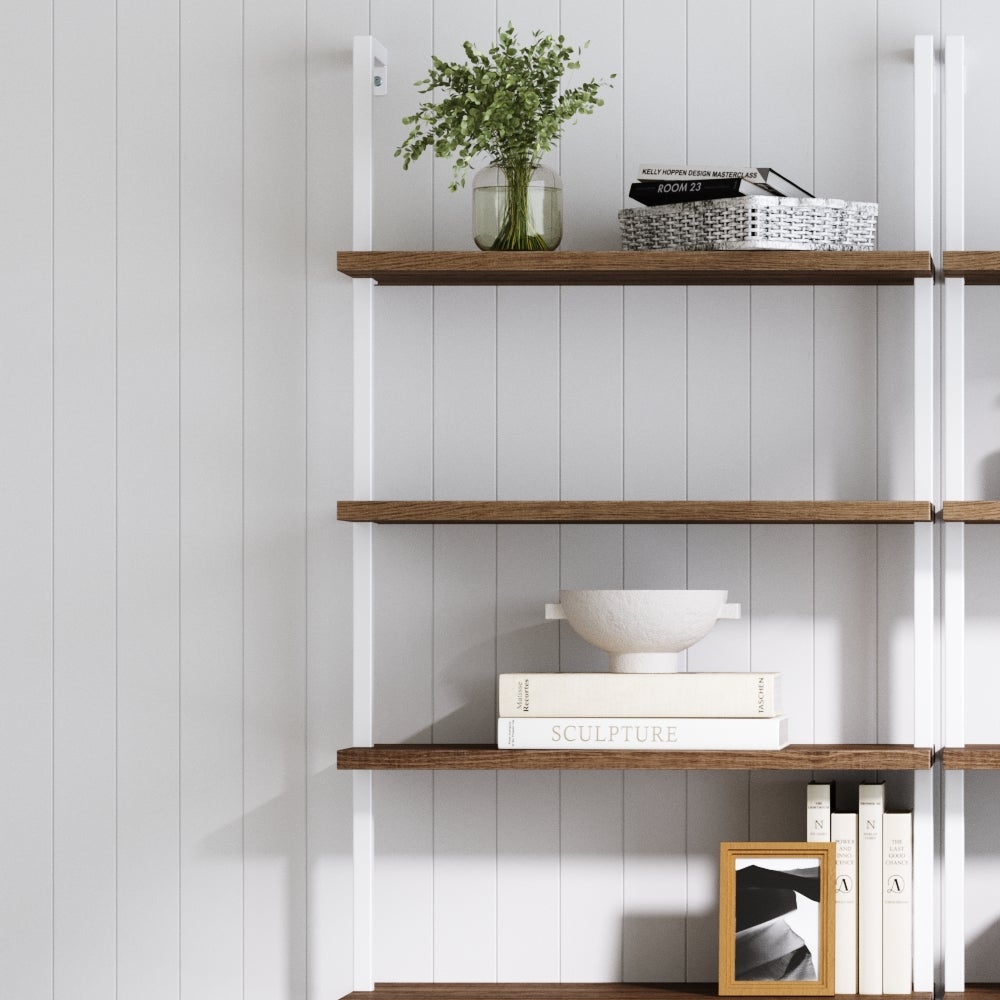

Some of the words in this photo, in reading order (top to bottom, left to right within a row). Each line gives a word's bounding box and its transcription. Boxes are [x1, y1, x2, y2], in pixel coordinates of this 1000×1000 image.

[658, 183, 688, 193] ROOM
[690, 182, 702, 192] 23
[552, 726, 678, 743] SCULPTURE
